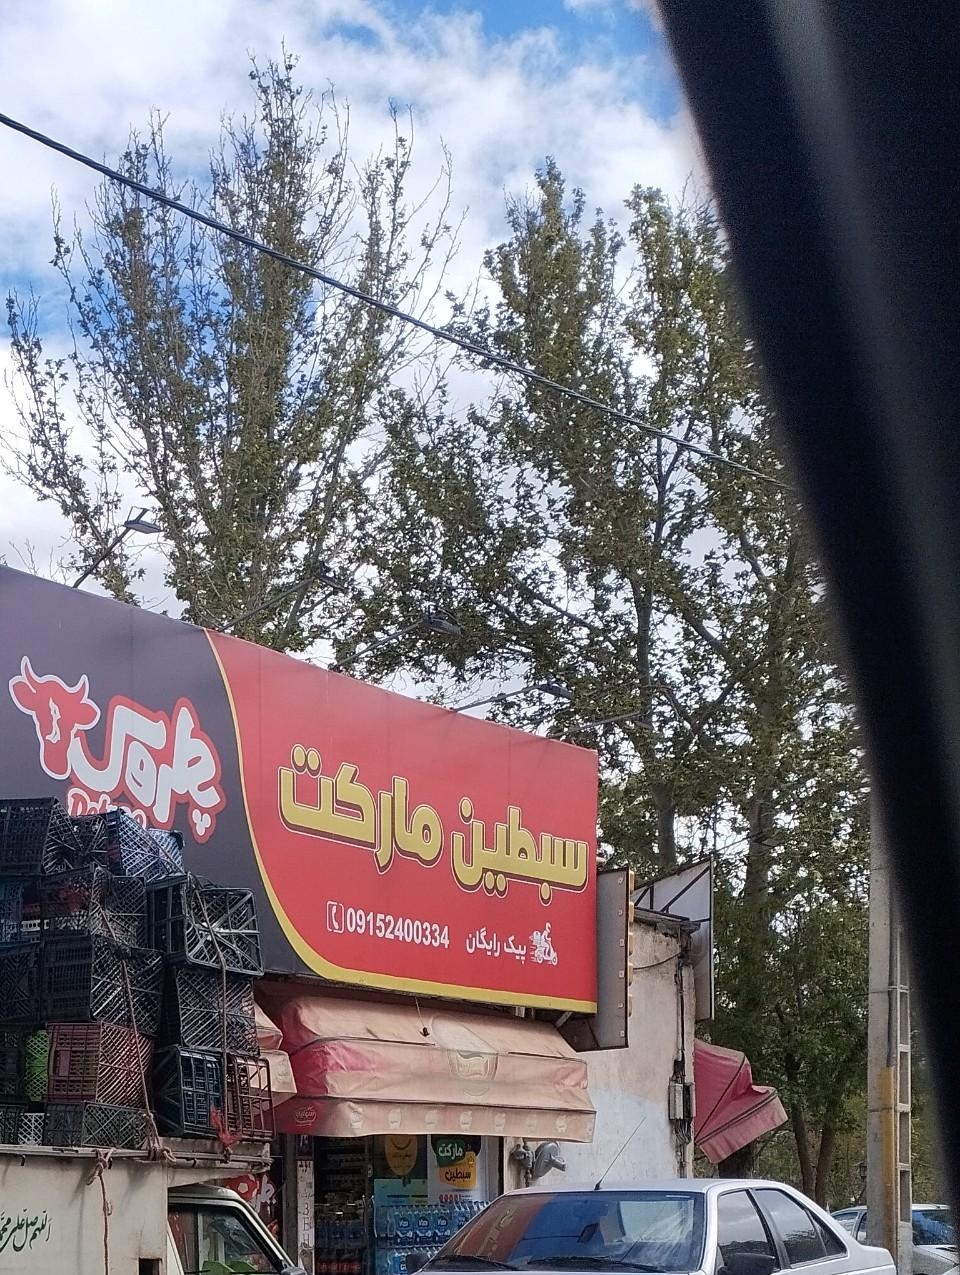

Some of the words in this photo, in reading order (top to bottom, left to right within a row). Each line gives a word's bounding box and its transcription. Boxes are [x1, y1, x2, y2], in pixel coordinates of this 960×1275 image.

[278, 744, 444, 874] مارکت
[451, 797, 589, 904] سبطین
[346, 906, 450, 949] 09152400334
[465, 930, 499, 957] رایگان
[501, 936, 528, 965] پیک
[445, 1169, 471, 1183] سبطین
